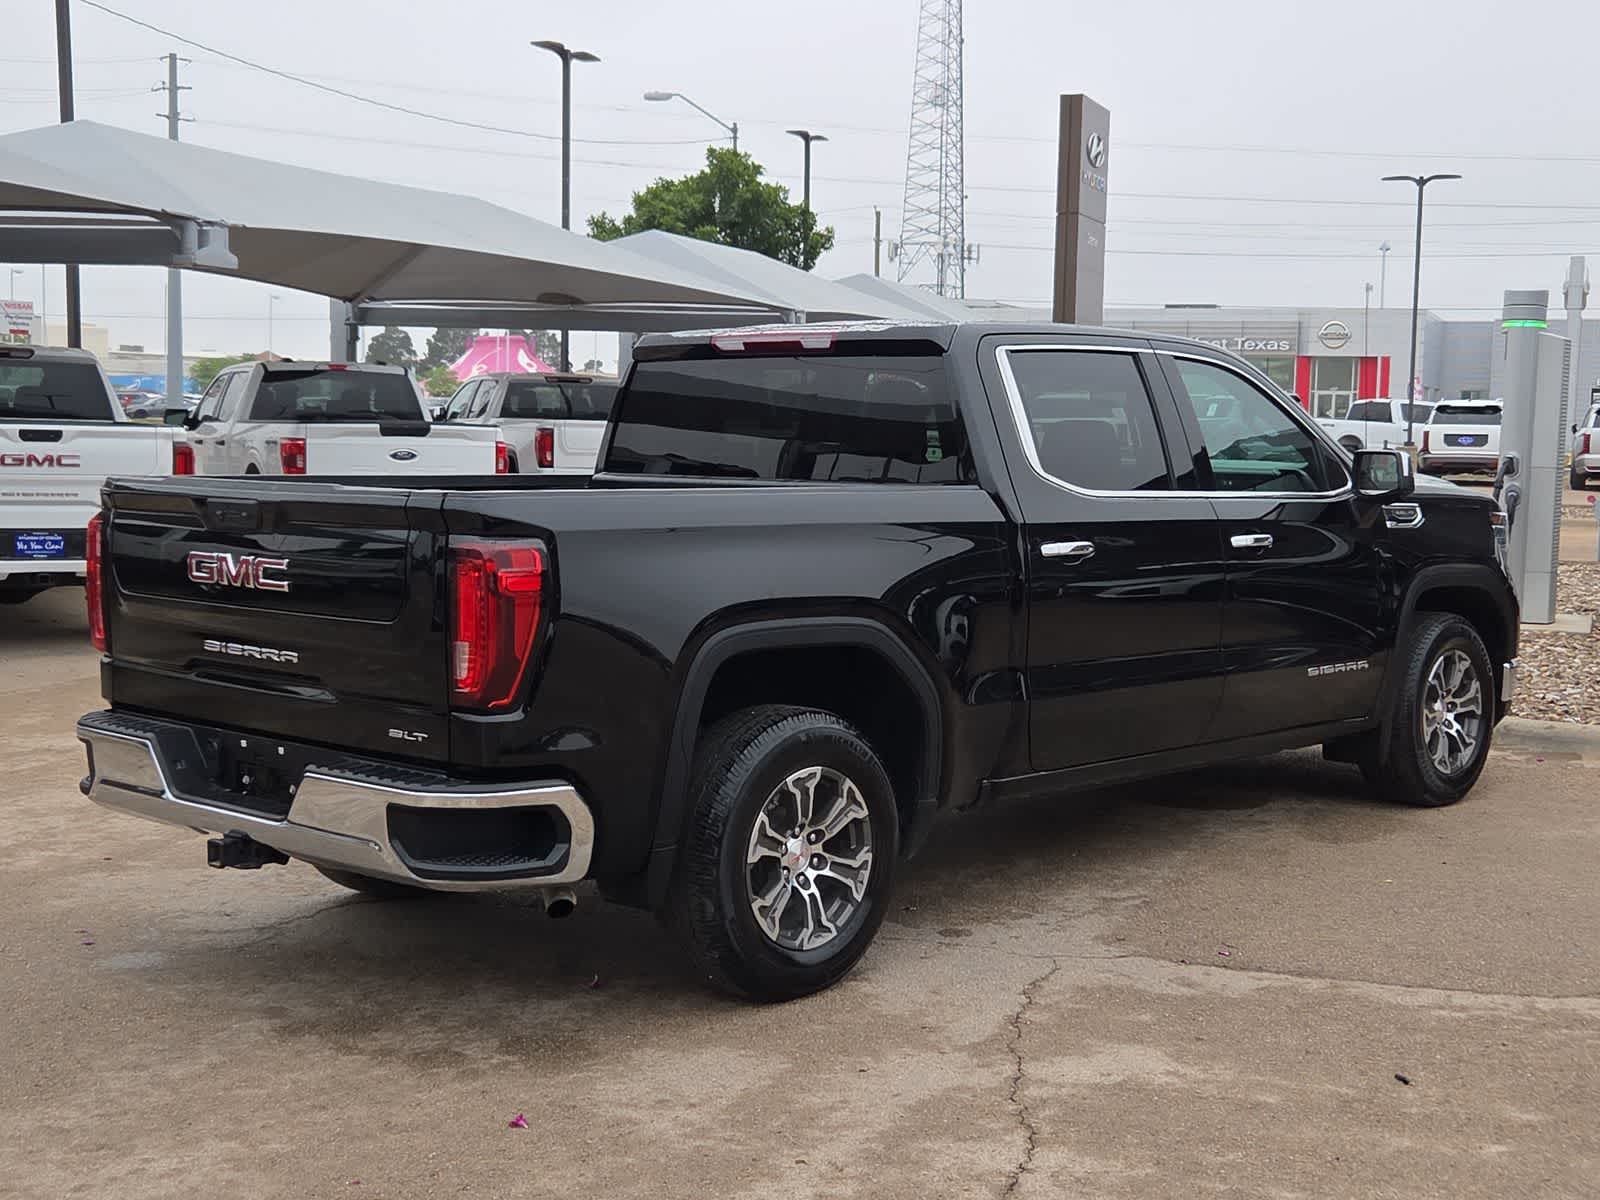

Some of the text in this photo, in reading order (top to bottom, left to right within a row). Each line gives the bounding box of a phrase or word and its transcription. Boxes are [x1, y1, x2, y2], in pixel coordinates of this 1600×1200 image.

[1192, 337, 1290, 351] st Texas
[0, 454, 80, 468] GMC
[187, 551, 289, 592] GMC
[203, 639, 299, 663] SIERRA
[1307, 660, 1369, 677] SIERRA
[388, 728, 429, 742] SLT
